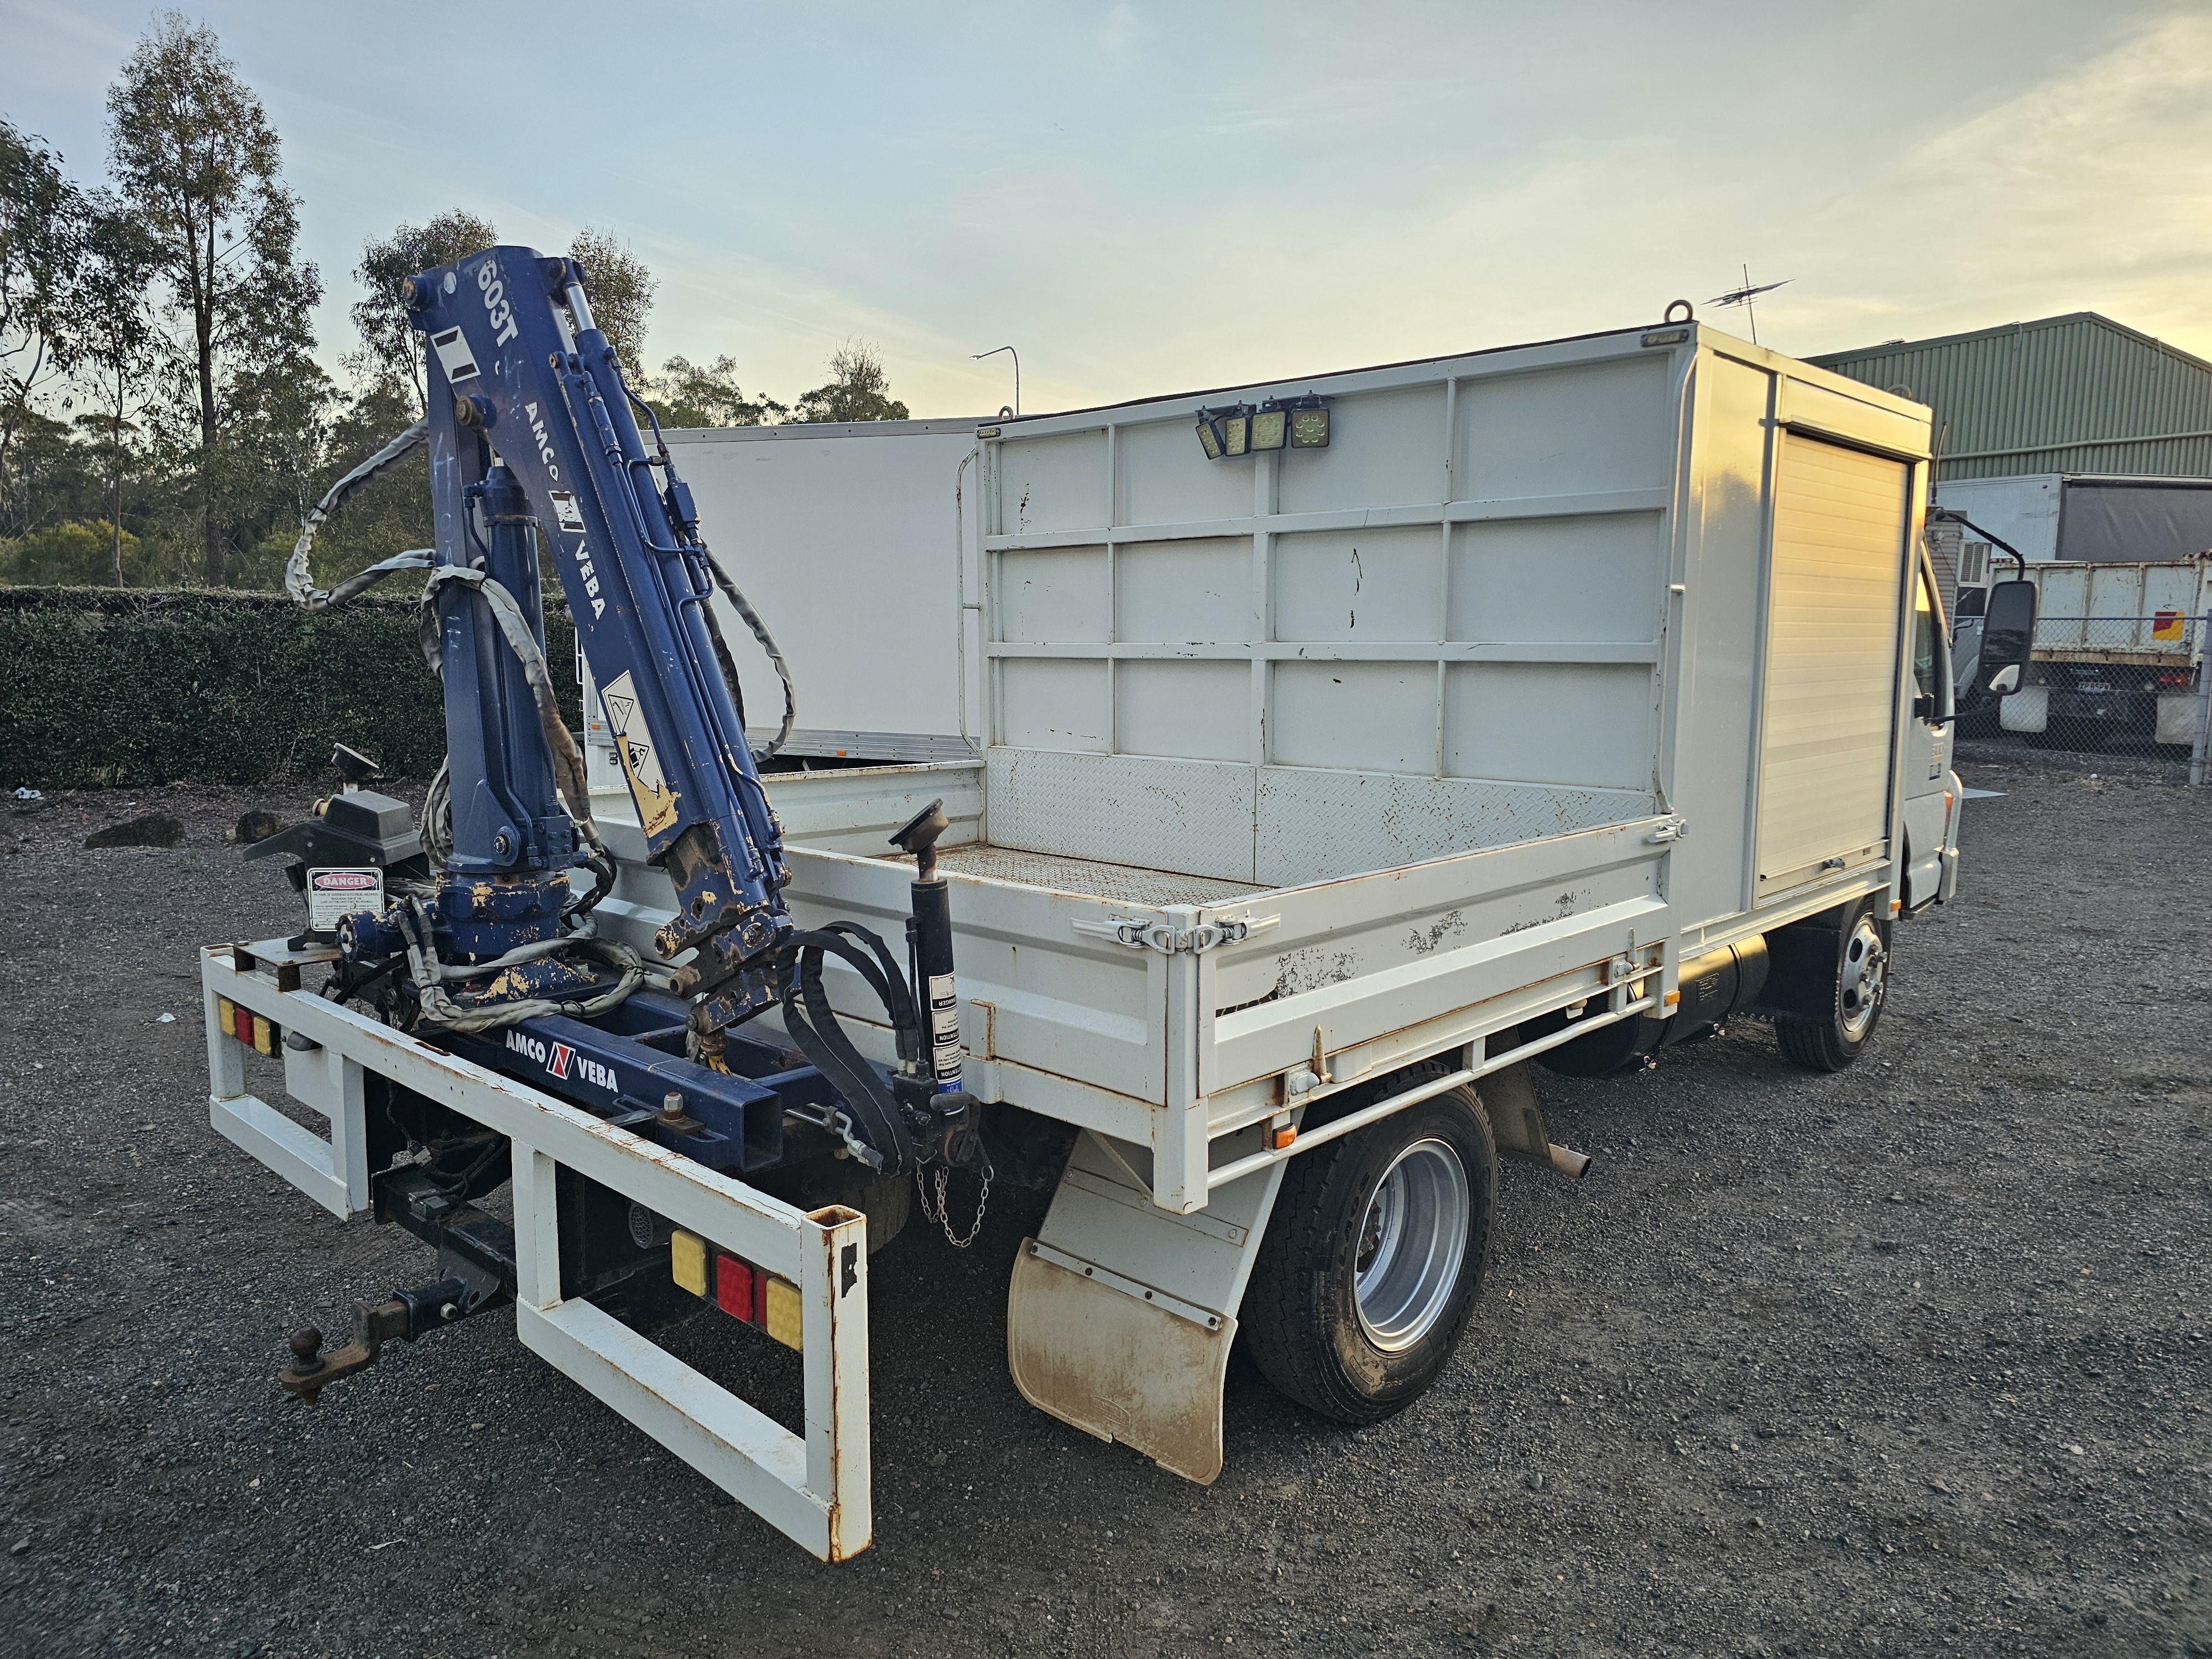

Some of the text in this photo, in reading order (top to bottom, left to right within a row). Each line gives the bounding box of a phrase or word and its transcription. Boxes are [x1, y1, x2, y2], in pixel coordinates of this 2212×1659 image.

[478, 260, 518, 347] 603T
[525, 401, 606, 620] AMCO VEBA
[324, 877, 367, 885] DANGER
[505, 1030, 618, 1093] AMCO VEBA
